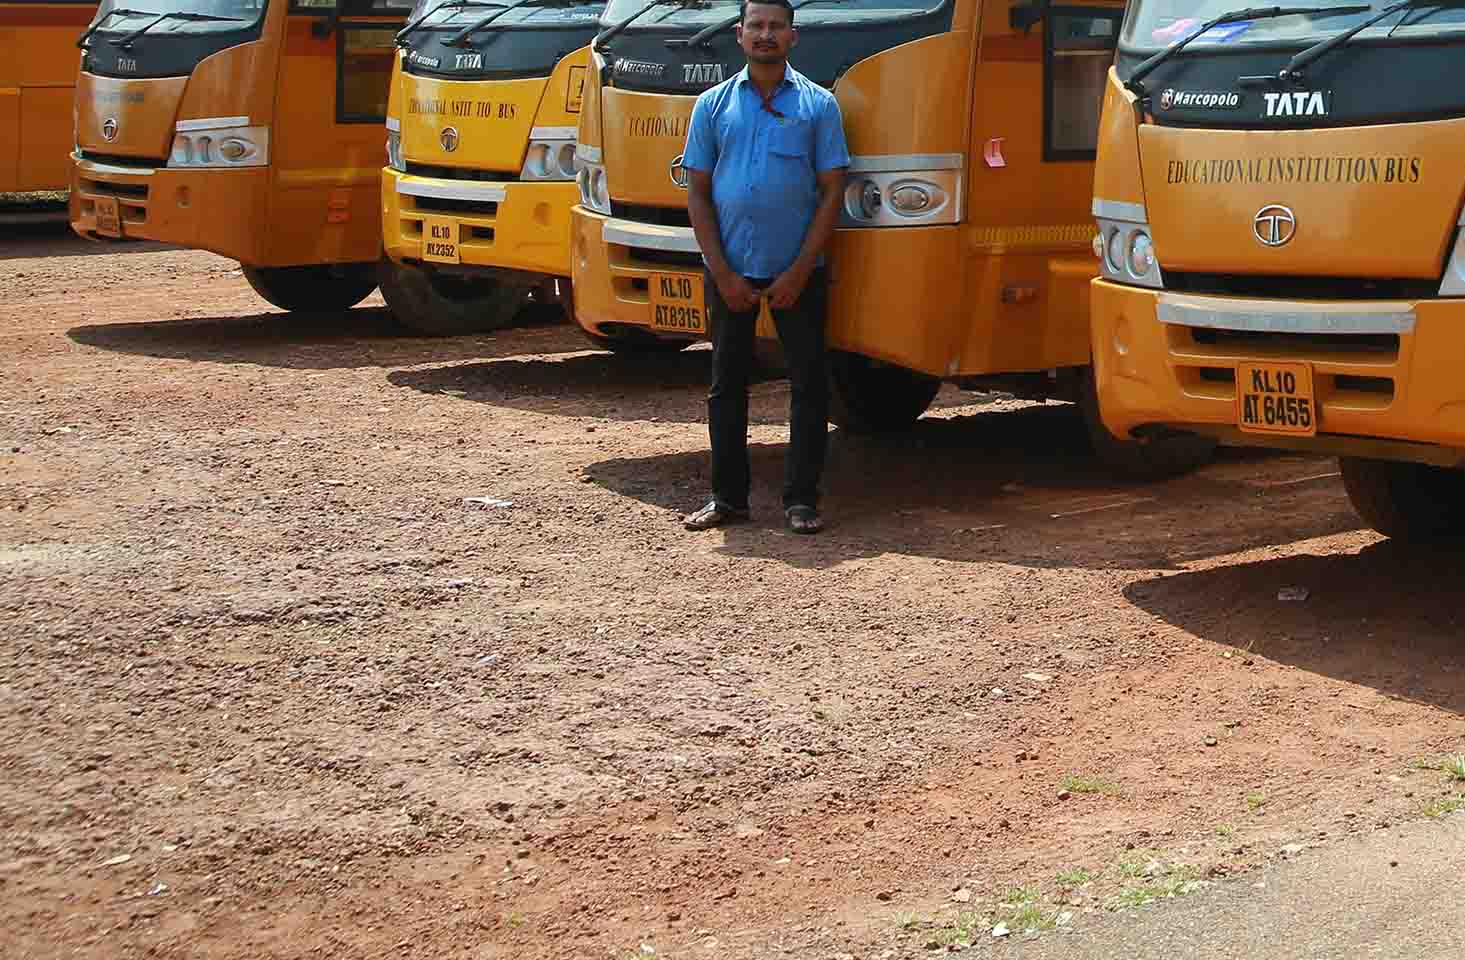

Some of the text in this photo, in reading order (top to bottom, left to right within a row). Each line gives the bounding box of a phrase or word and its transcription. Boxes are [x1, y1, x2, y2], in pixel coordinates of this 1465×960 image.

[117, 58, 137, 72] TATA
[682, 63, 724, 83] TATA
[1173, 90, 1240, 107] Marcopolo
[1264, 91, 1329, 117] TATA
[498, 103, 516, 119] BUS
[1167, 156, 1421, 184] EDUCATIONAL INSTITUTION BUS
